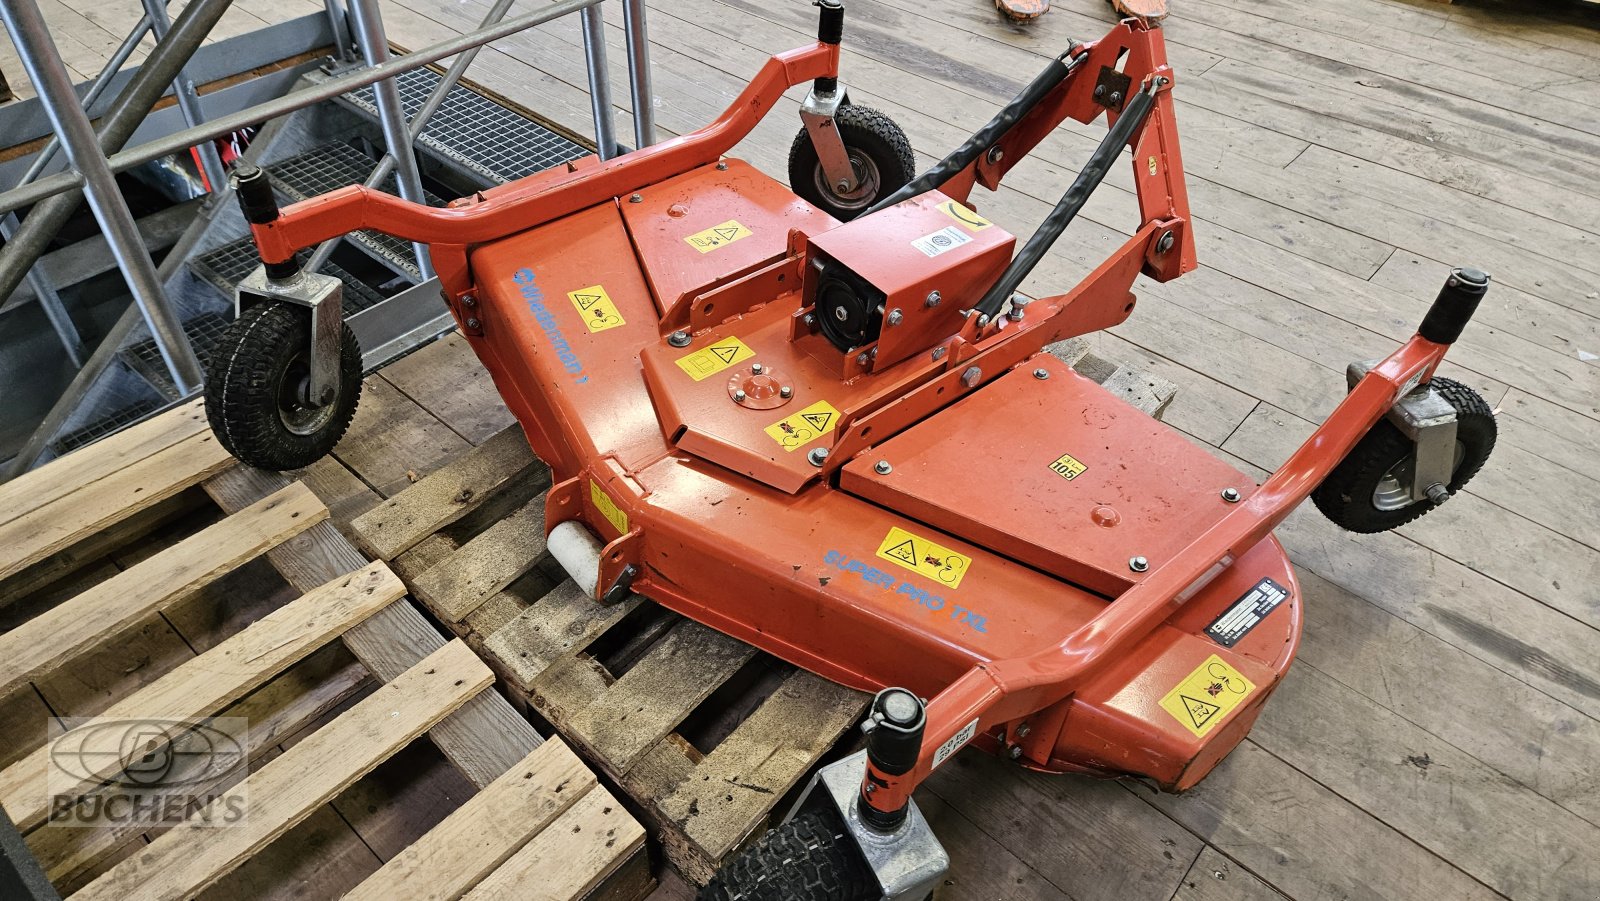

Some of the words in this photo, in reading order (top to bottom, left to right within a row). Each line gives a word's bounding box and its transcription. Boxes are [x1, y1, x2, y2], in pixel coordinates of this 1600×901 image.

[1053, 461, 1077, 479] 105
[823, 549, 896, 590] SUPER
[896, 582, 945, 611] PRO
[950, 604, 988, 634] TXL
[956, 724, 973, 741] bar
[938, 749, 951, 762] 29
[952, 733, 969, 750] PSI
